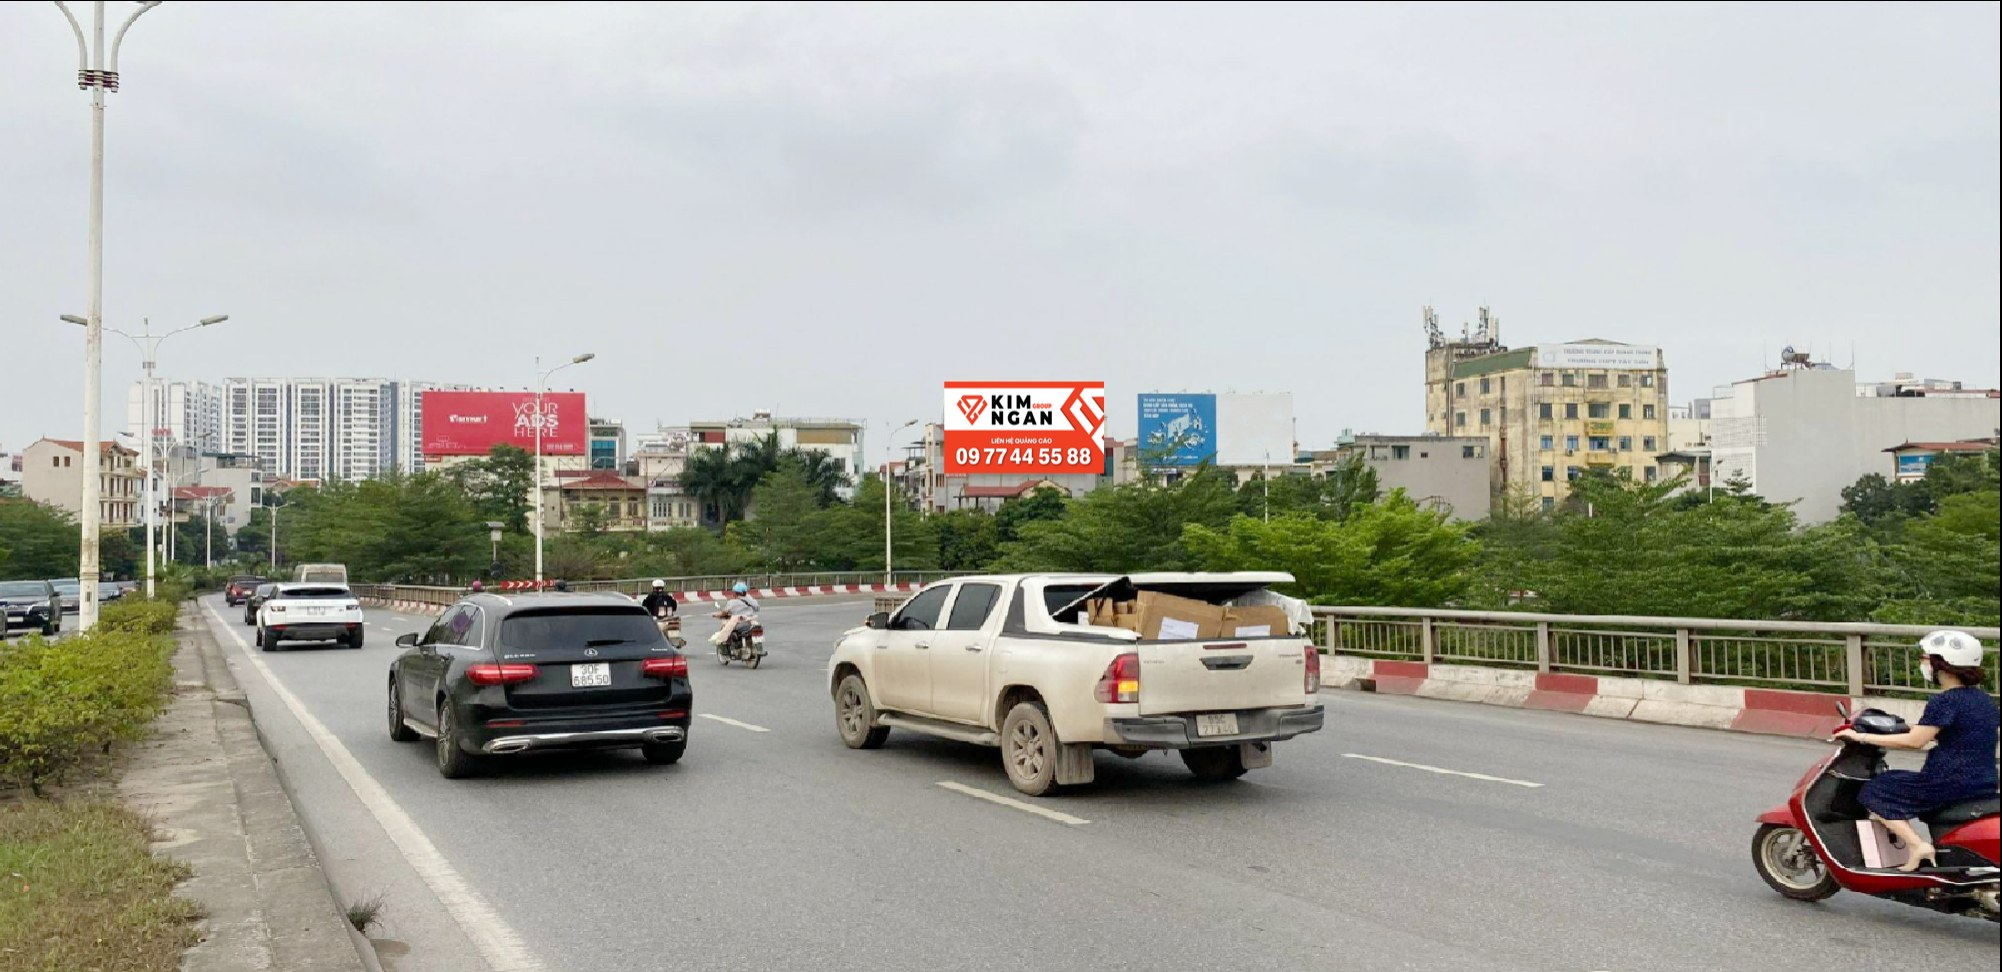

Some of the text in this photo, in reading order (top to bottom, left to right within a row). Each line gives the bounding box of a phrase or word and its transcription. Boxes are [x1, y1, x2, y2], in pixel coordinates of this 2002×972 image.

[512, 402, 558, 416] YOUR
[991, 395, 1031, 409] KIM
[514, 414, 559, 427] ADS
[991, 411, 1052, 426] NGAN
[514, 427, 558, 438] HERE
[956, 447, 980, 465] 09
[1038, 447, 1063, 465] 55
[1066, 447, 1091, 465] 88
